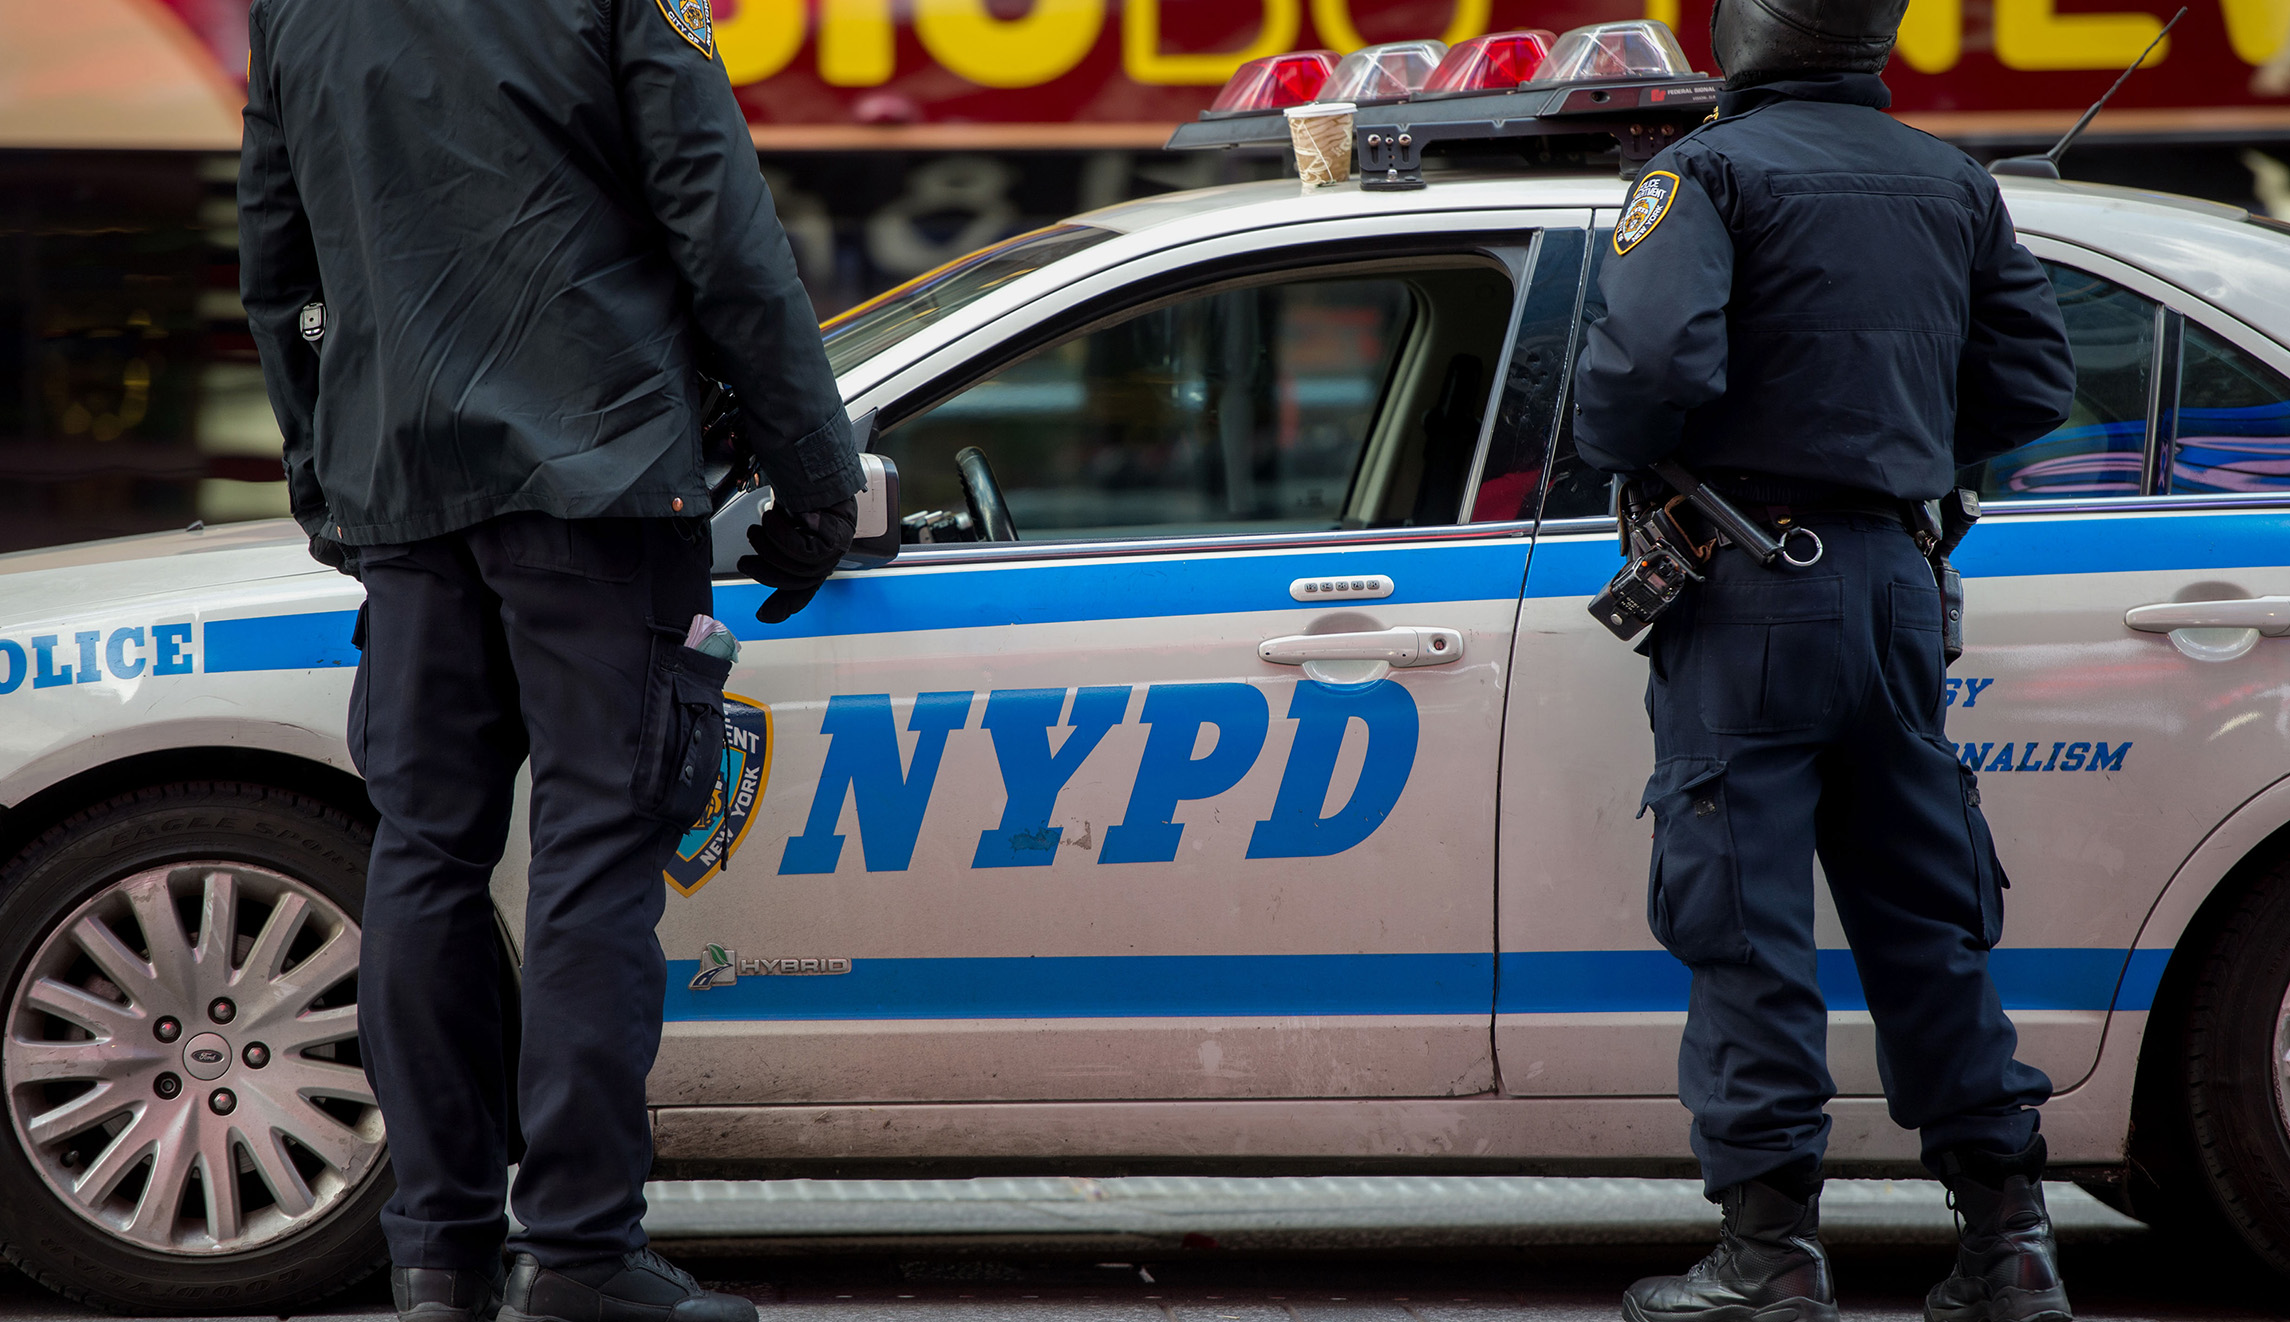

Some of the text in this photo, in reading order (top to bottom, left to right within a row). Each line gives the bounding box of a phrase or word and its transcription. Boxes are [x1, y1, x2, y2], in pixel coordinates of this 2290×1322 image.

[668, 11, 687, 32] CITY
[687, 32, 700, 44] OF
[1631, 226, 1647, 242] NEW
[1645, 205, 1664, 225] YORK
[778, 679, 1420, 875] NYPD
[110, 816, 365, 878] EAGLE SPORT
[700, 766, 760, 867] NEW YORK
[740, 958, 849, 973] HYBRID
[40, 1236, 305, 1300] GOODYEAR
